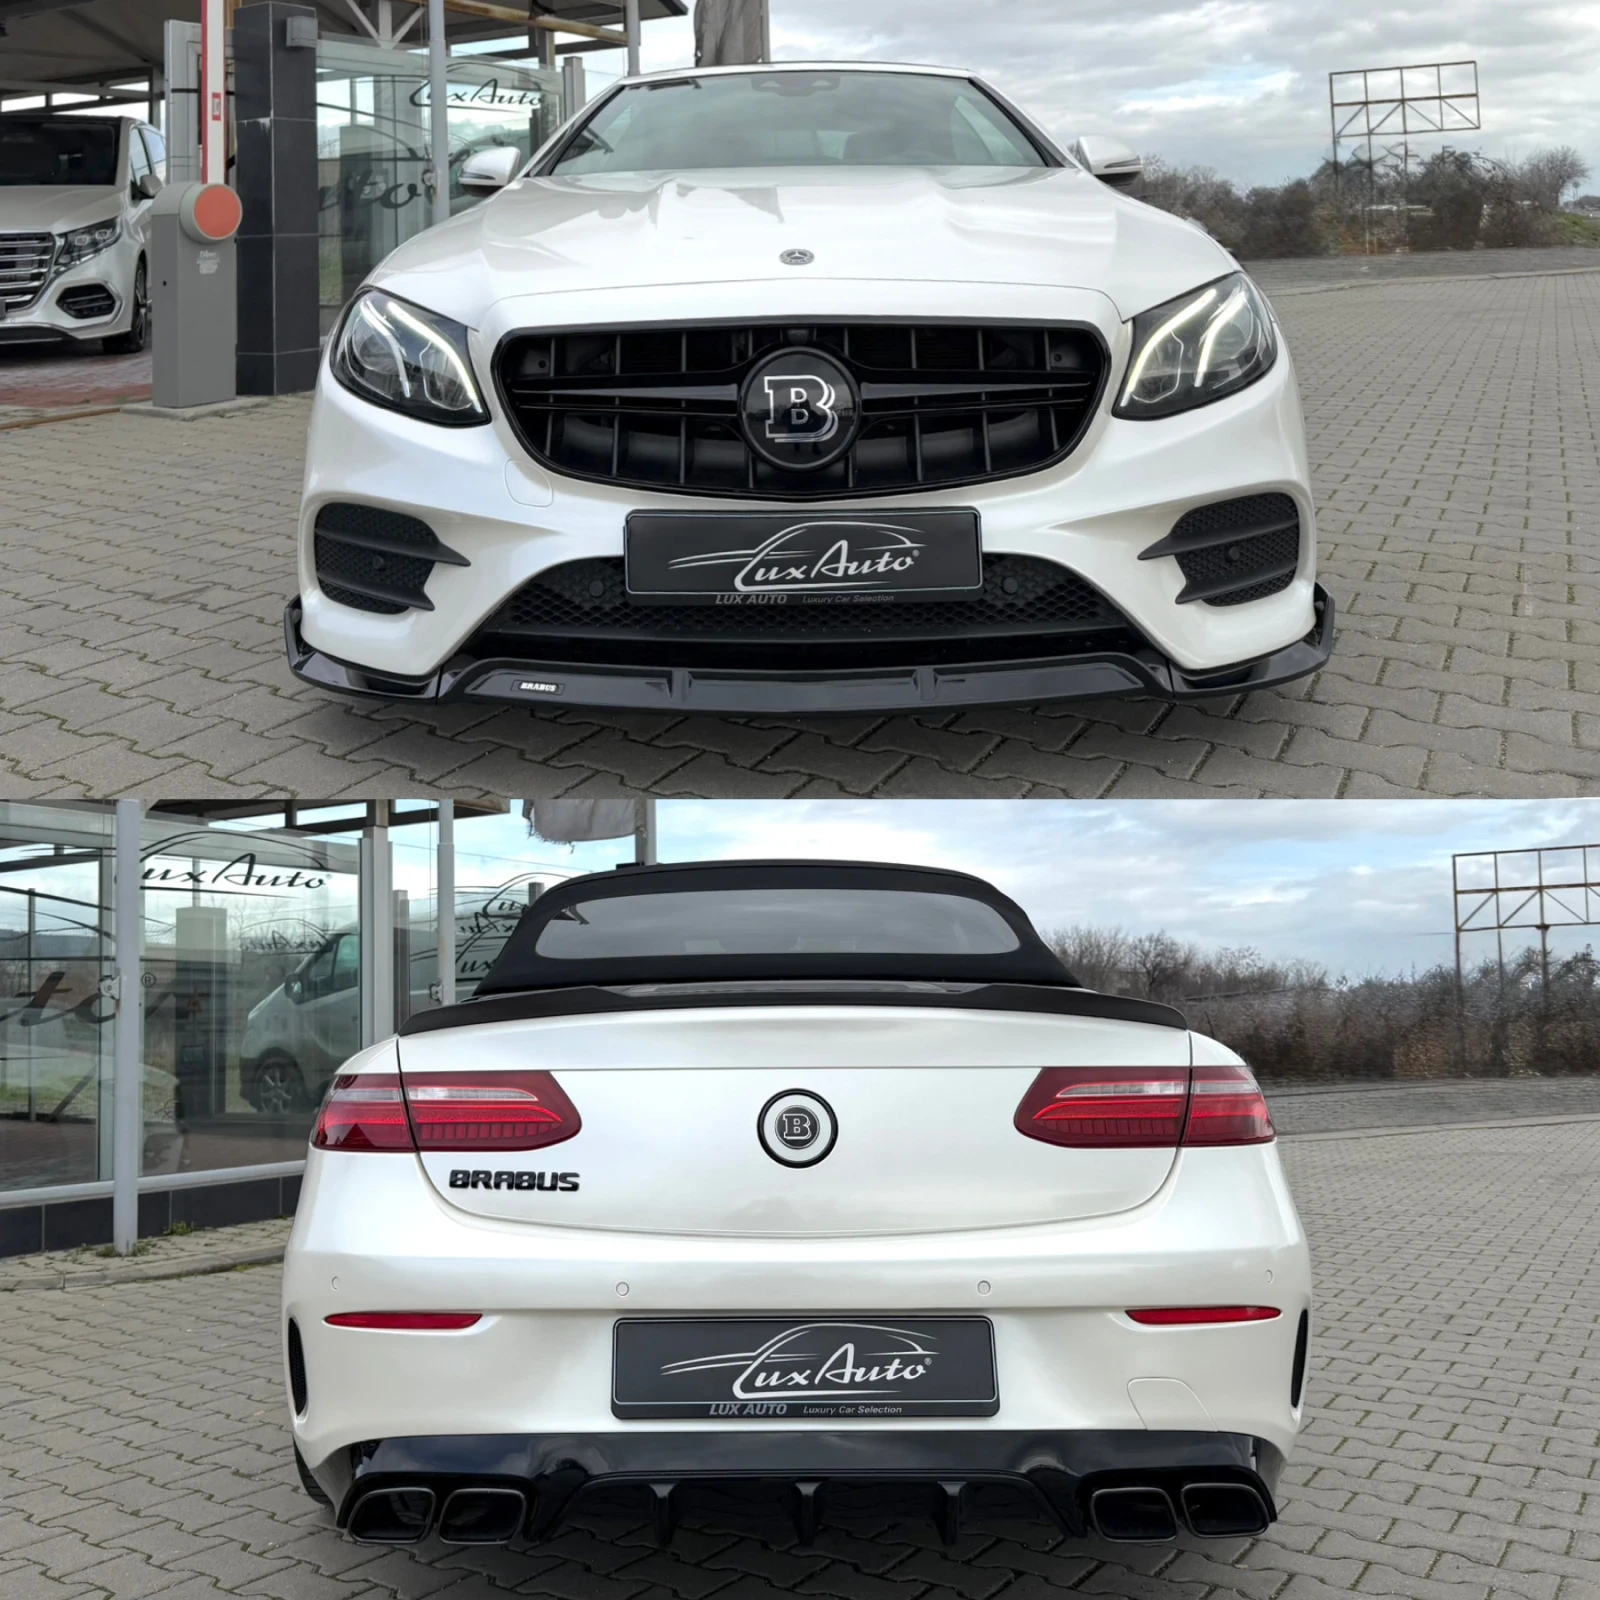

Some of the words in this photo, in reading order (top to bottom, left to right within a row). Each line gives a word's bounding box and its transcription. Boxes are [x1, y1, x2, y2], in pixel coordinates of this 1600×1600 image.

[715, 594, 742, 605] LUX
[746, 594, 787, 605] AUTO
[802, 595, 833, 605] Luxury
[835, 595, 851, 604] Car
[853, 593, 895, 603] Selection
[520, 682, 557, 692] BRABUS
[449, 1169, 580, 1192] BRABUS
[709, 1403, 741, 1416] LUX
[743, 1403, 788, 1416] AUTO
[803, 1405, 836, 1415] Luxury
[838, 1405, 856, 1414] Car
[857, 1405, 902, 1414] Selection
